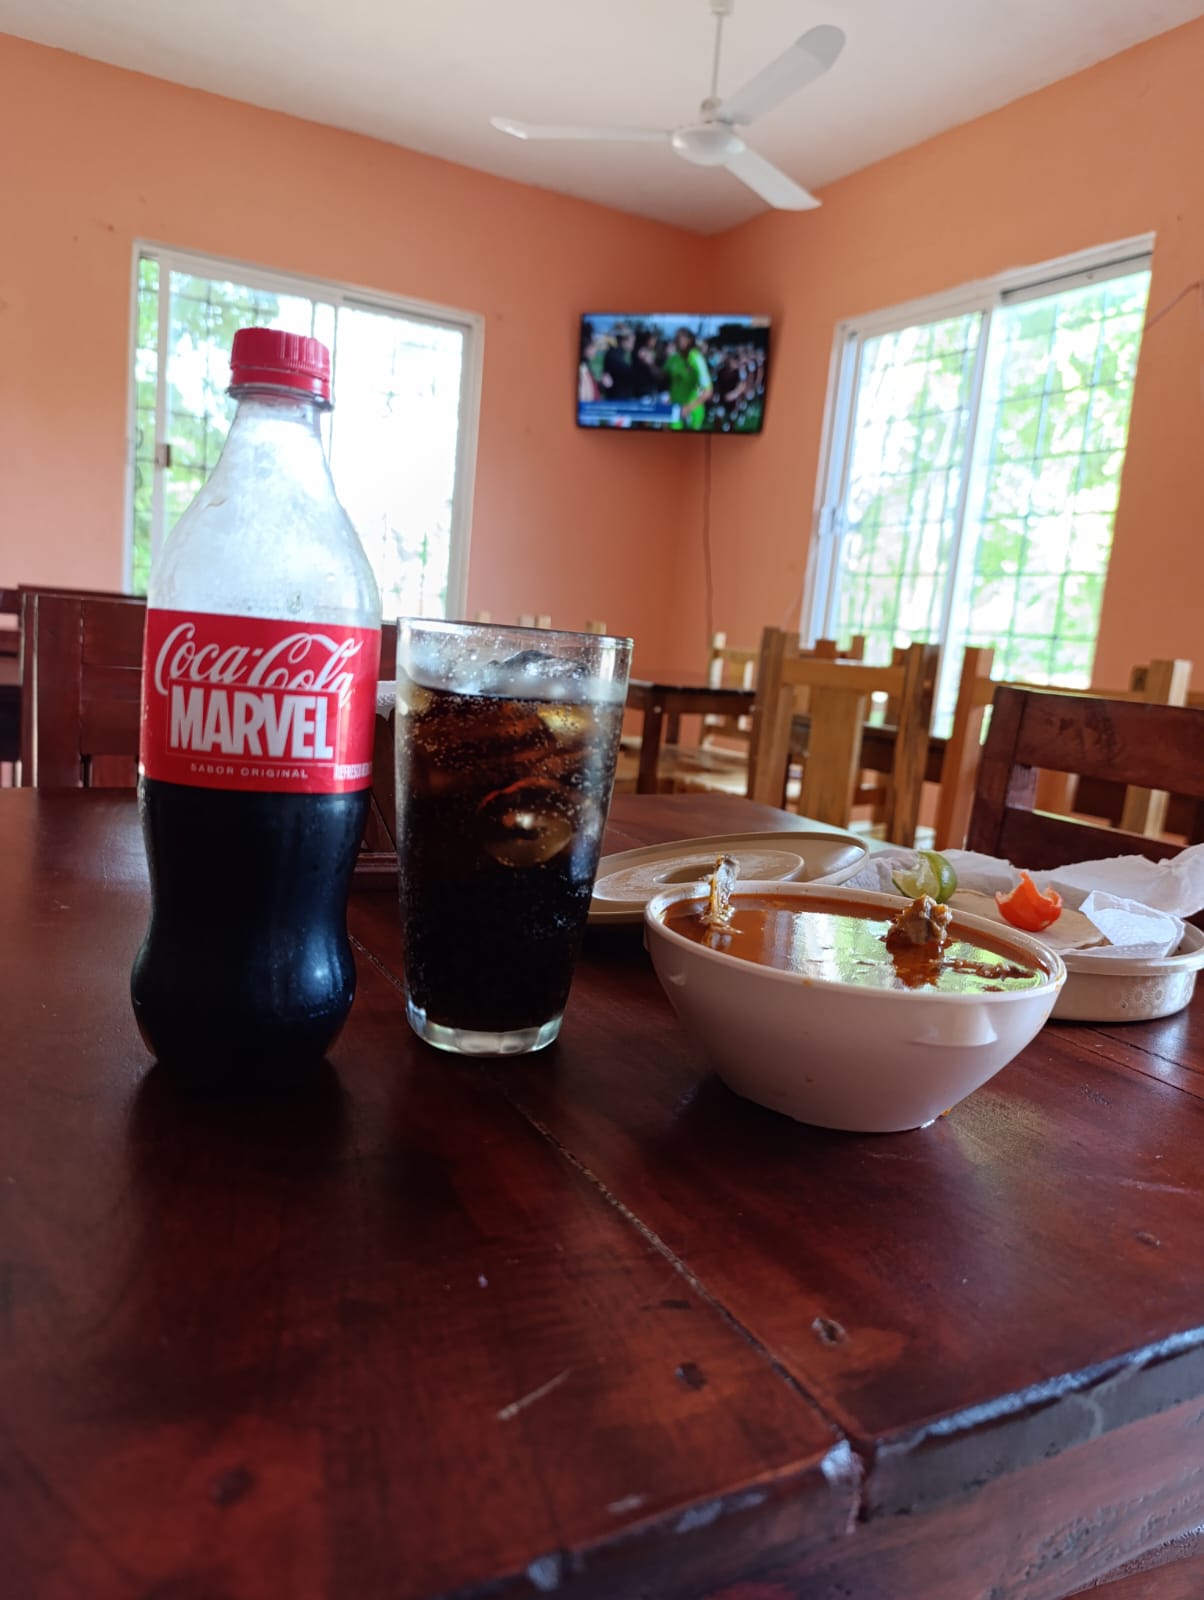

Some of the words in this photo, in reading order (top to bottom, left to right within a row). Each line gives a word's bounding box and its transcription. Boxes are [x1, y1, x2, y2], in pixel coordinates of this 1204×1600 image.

[154, 622, 364, 707] Coca-Cola
[170, 684, 334, 761] MARVEL
[190, 762, 234, 775] SABOR
[240, 767, 309, 779] ORIGINAL
